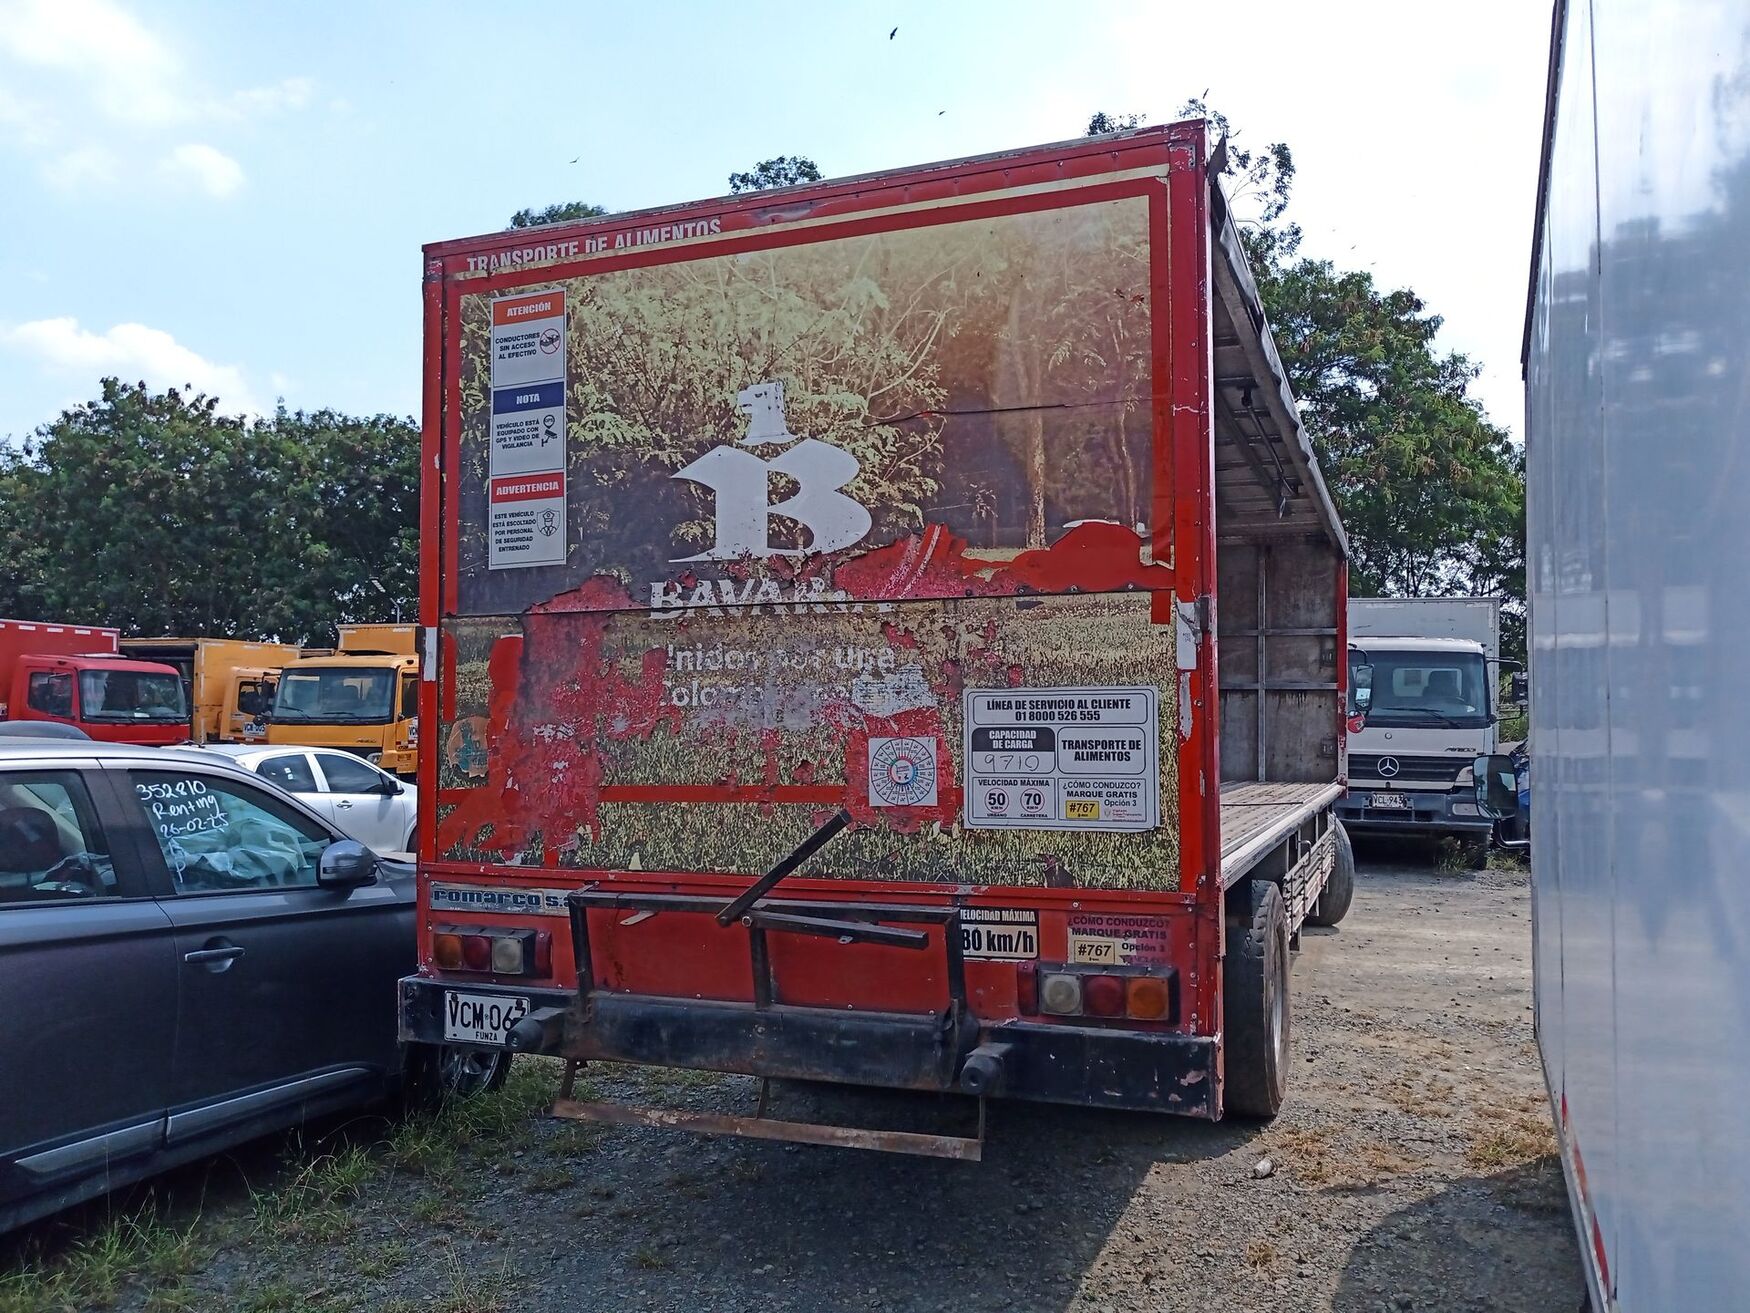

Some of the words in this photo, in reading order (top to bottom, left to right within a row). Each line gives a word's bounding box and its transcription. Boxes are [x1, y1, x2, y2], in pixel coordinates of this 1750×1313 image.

[467, 240, 579, 272] TRANSPORTE
[586, 235, 607, 253] DE
[614, 218, 721, 249] ALIMENTOS
[507, 301, 551, 317] ATENCIÓN
[495, 332, 540, 344] CONDUCTORES
[511, 341, 535, 350] ACCESO
[508, 349, 536, 358] EFECTIVO
[516, 393, 540, 405] NOTA
[496, 421, 524, 430] VEHÍCULO
[496, 429, 525, 437] EQUIPADO
[502, 441, 533, 450] VIGILANCIA
[496, 481, 559, 496] ADVERTENCIA
[494, 512, 507, 520] ESTE
[506, 518, 536, 527] ESCOLTADO
[504, 536, 533, 544] SEGURIDAD
[498, 544, 530, 553] ENTRENADO
[986, 698, 1013, 711] LÍNEA
[1015, 700, 1027, 710] DE
[1028, 698, 1074, 710] SERVICIO
[1077, 699, 1089, 710] AL
[1091, 698, 1130, 710] CLIENTE
[1015, 711, 1027, 721] 01
[1029, 711, 1056, 721] 8000
[1058, 711, 1078, 721] 526
[1080, 710, 1101, 721] 555
[989, 730, 1036, 740] CAPACIDAD
[992, 740, 1004, 749] DE
[1004, 740, 1034, 749] CARGA
[1062, 740, 1126, 750] TRANSPORTE
[1128, 740, 1142, 750] DE
[1074, 752, 1131, 762] ALIMENTOS
[984, 754, 1040, 773] 9710
[1020, 778, 1050, 786] MÁXIMA
[1062, 780, 1091, 790] ¿CÓMO
[136, 780, 206, 800] 352810
[1066, 790, 1104, 798] MARQUE
[988, 793, 1006, 806] 50
[1024, 793, 1042, 806] 70
[1104, 799, 1130, 808] Opción
[152, 794, 220, 820] Renting
[1069, 802, 1096, 812] #767
[1002, 909, 1036, 922] MÁXIMA
[1106, 917, 1170, 928] CONDUZCO?
[1071, 927, 1120, 937] MARQUE
[1123, 929, 1167, 940] GRATIS
[961, 927, 982, 951] 80
[986, 930, 1034, 952] km/h
[1078, 943, 1112, 956] #767
[1121, 942, 1156, 952] Opción
[475, 1031, 498, 1041] FUNZA
